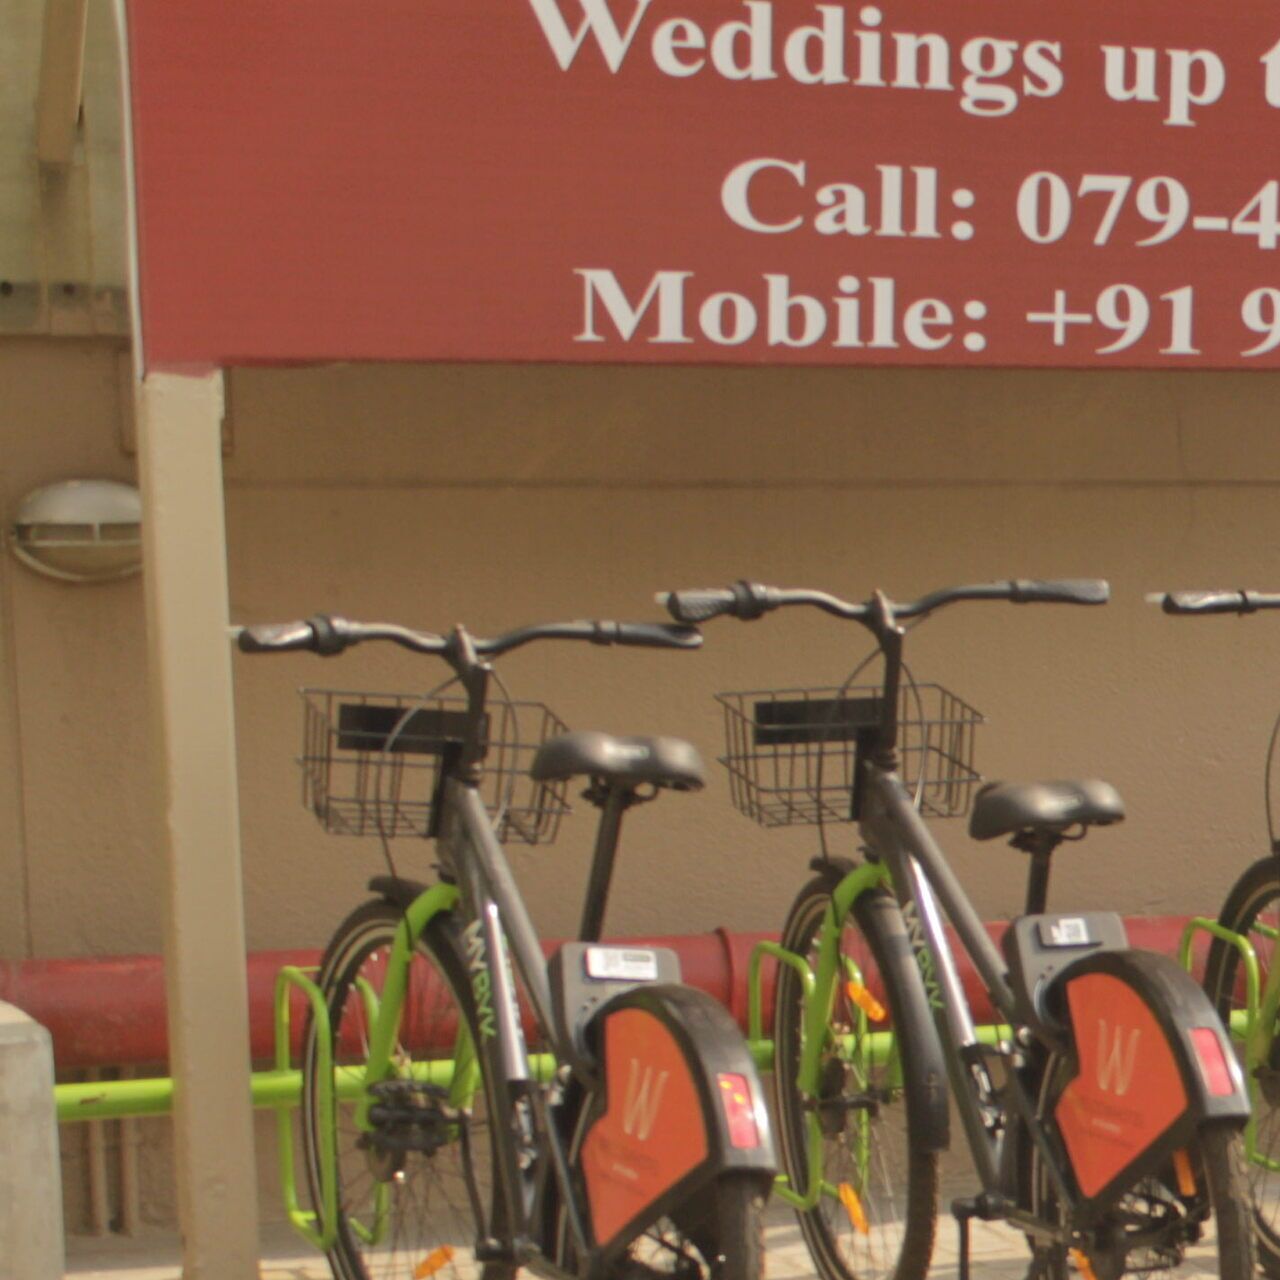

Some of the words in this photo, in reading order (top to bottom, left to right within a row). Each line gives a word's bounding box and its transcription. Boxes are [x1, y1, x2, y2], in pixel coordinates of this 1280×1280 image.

[530, 0, 1063, 117] Weddings
[1101, 45, 1226, 126] up
[721, 158, 974, 241] Call:
[575, 268, 987, 352] Mobile:
[1026, 283, 1200, 355] +91
[623, 1057, 669, 1141] W
[1097, 1018, 1142, 1096] W
